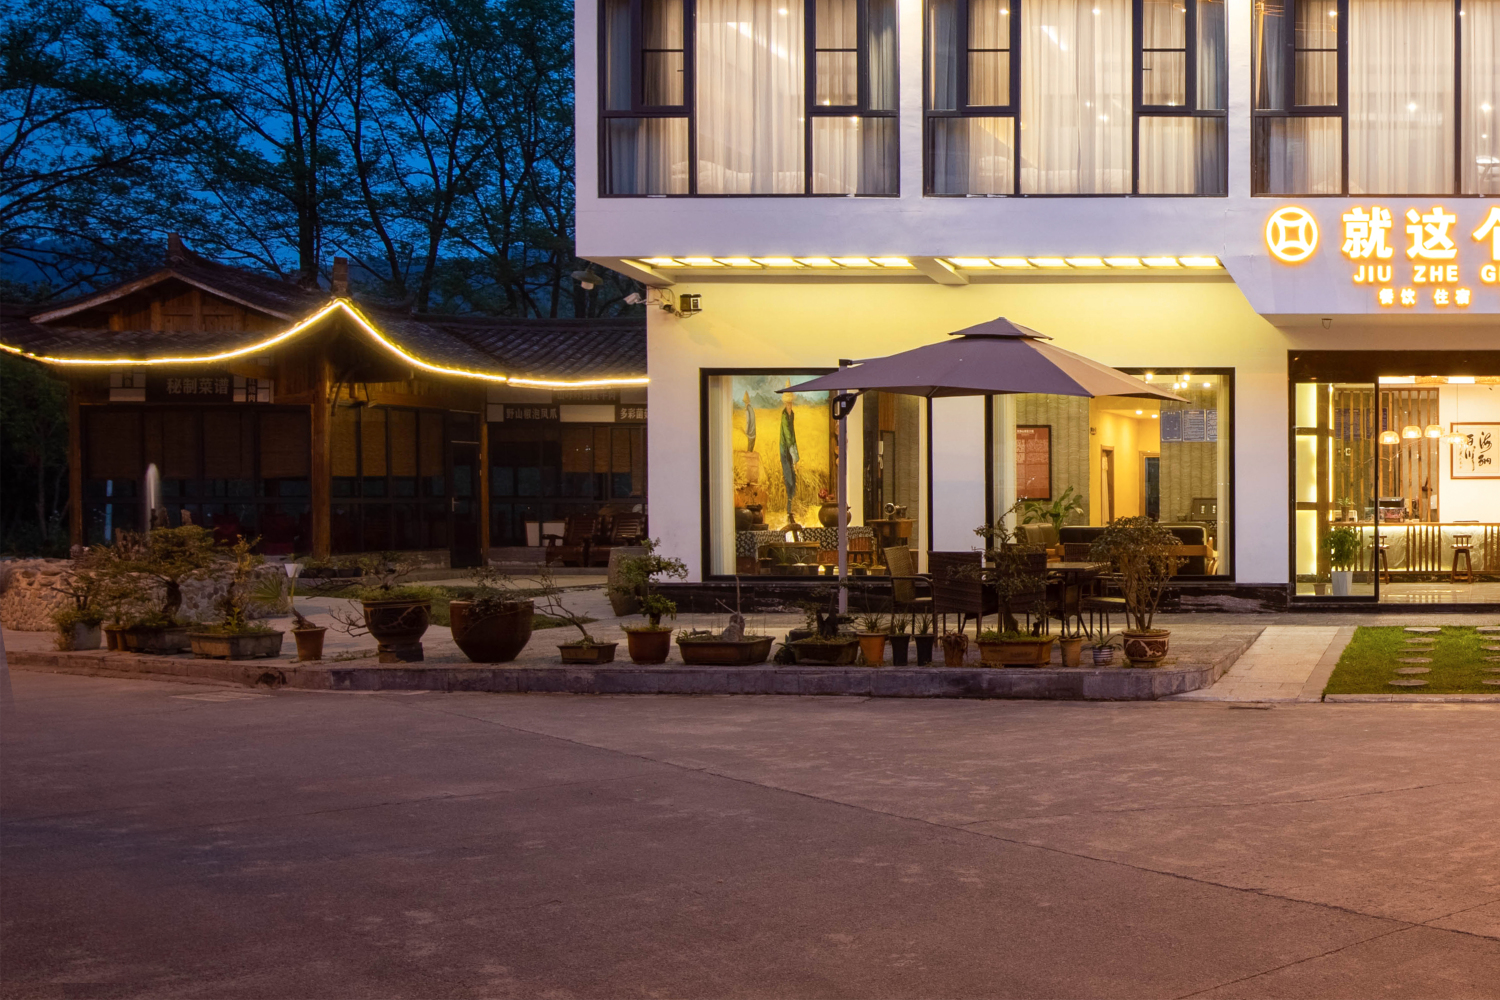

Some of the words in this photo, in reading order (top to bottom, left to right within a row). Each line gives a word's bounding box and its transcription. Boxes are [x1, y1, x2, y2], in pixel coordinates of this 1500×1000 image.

[1354, 265, 1391, 282] JIU
[1414, 265, 1458, 282] ZHE
[1379, 288, 1415, 304] 餐饮
[1434, 288, 1470, 304] 住宿
[166, 377, 229, 395] 秘制菜谱
